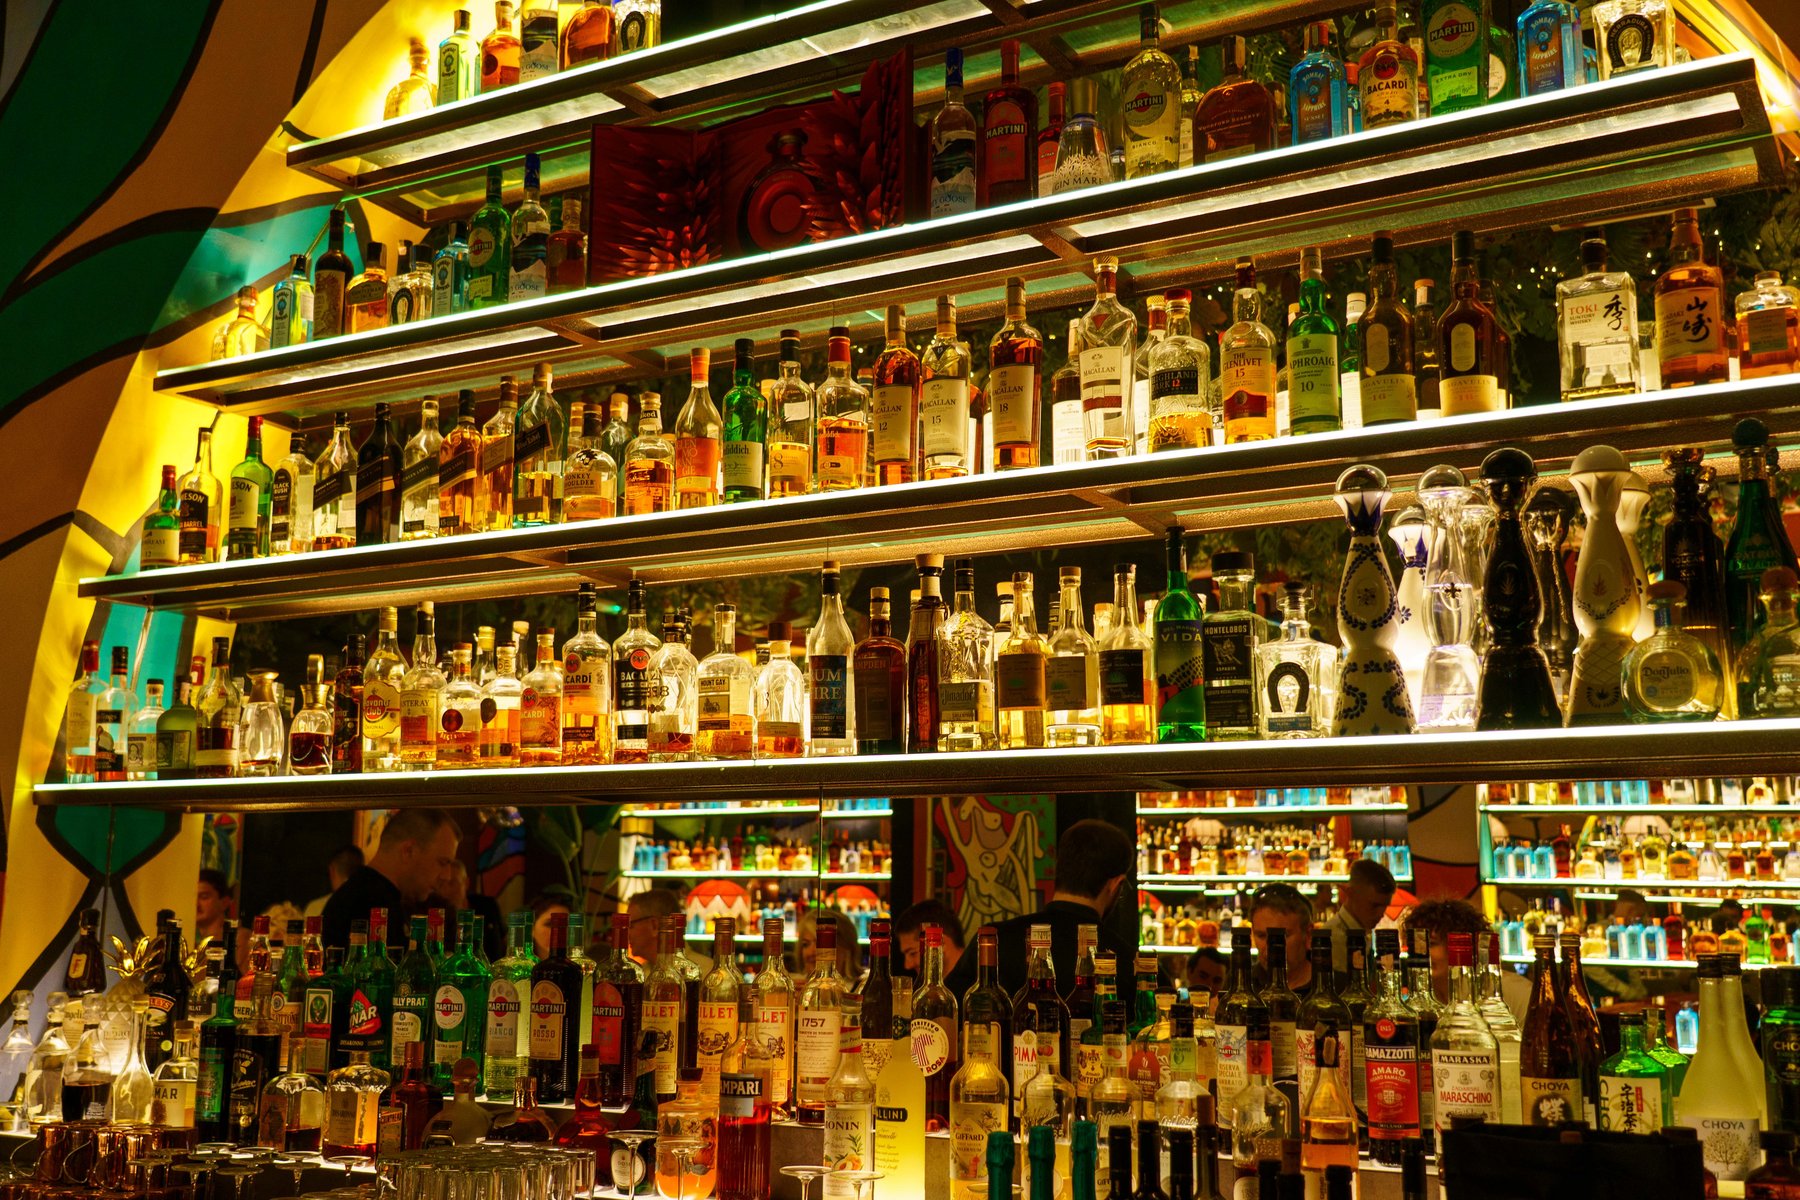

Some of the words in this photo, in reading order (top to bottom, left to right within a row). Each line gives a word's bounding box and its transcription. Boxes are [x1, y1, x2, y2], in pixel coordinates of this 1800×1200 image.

[1430, 22, 1475, 42] MARTINI
[1124, 94, 1164, 112] MARTINI
[986, 122, 1025, 139] MARTINI
[1054, 179, 1071, 191] GIN
[1568, 303, 1599, 316] TOKI
[1223, 357, 1262, 372] GLENLIVET
[1235, 367, 1245, 378] 15
[1171, 379, 1181, 388] 12
[1301, 380, 1314, 392] 10
[999, 403, 1009, 413] 18
[932, 415, 942, 425] 15
[879, 421, 888, 431] 12
[773, 454, 784, 470] 8
[1204, 625, 1248, 636] MONTELOBOS
[1160, 632, 1203, 643] VIDA
[407, 997, 426, 1006] PRAT
[488, 1001, 519, 1012] MARTINI
[436, 1003, 463, 1012] MARTINI
[531, 1003, 563, 1014] MARTINI
[801, 1017, 826, 1029] 1757
[533, 1029, 556, 1039] ROSSO
[1365, 1047, 1416, 1060] RAMAZZOTTI
[925, 1056, 946, 1074] ROSA
[1440, 1055, 1490, 1064] MARASKA
[1371, 1066, 1406, 1079] AMARO
[1531, 1081, 1570, 1092] CHOYA
[1440, 1090, 1492, 1104] MARASCHINO
[1702, 1120, 1745, 1131] CHOYA
[955, 1132, 985, 1141] GIFFARD
